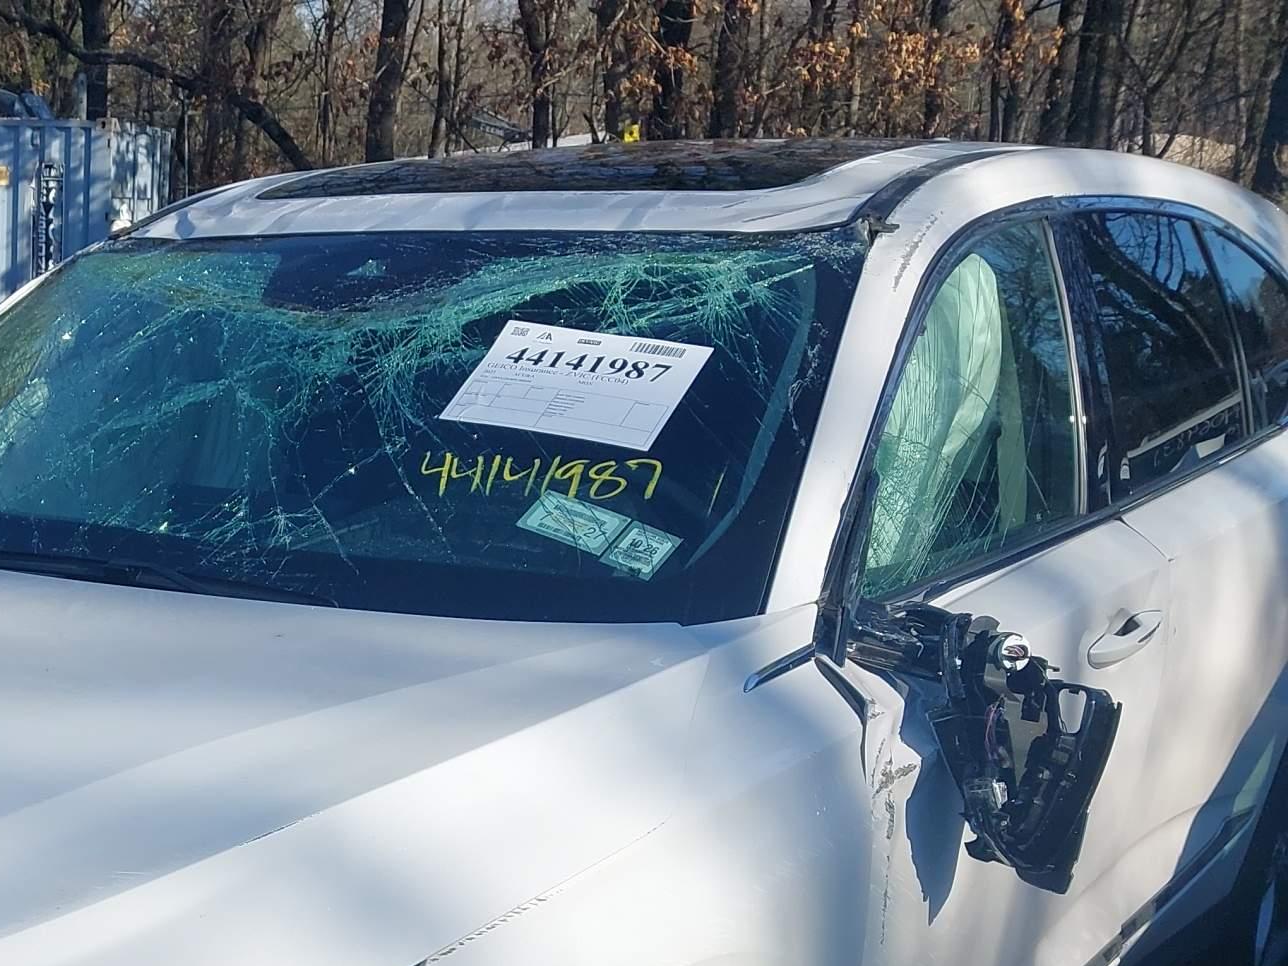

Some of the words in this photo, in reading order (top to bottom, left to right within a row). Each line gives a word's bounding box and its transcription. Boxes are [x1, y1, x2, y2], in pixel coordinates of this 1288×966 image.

[505, 347, 672, 382] 44141987
[519, 364, 560, 375] Insurance
[420, 451, 663, 500] 44141987
